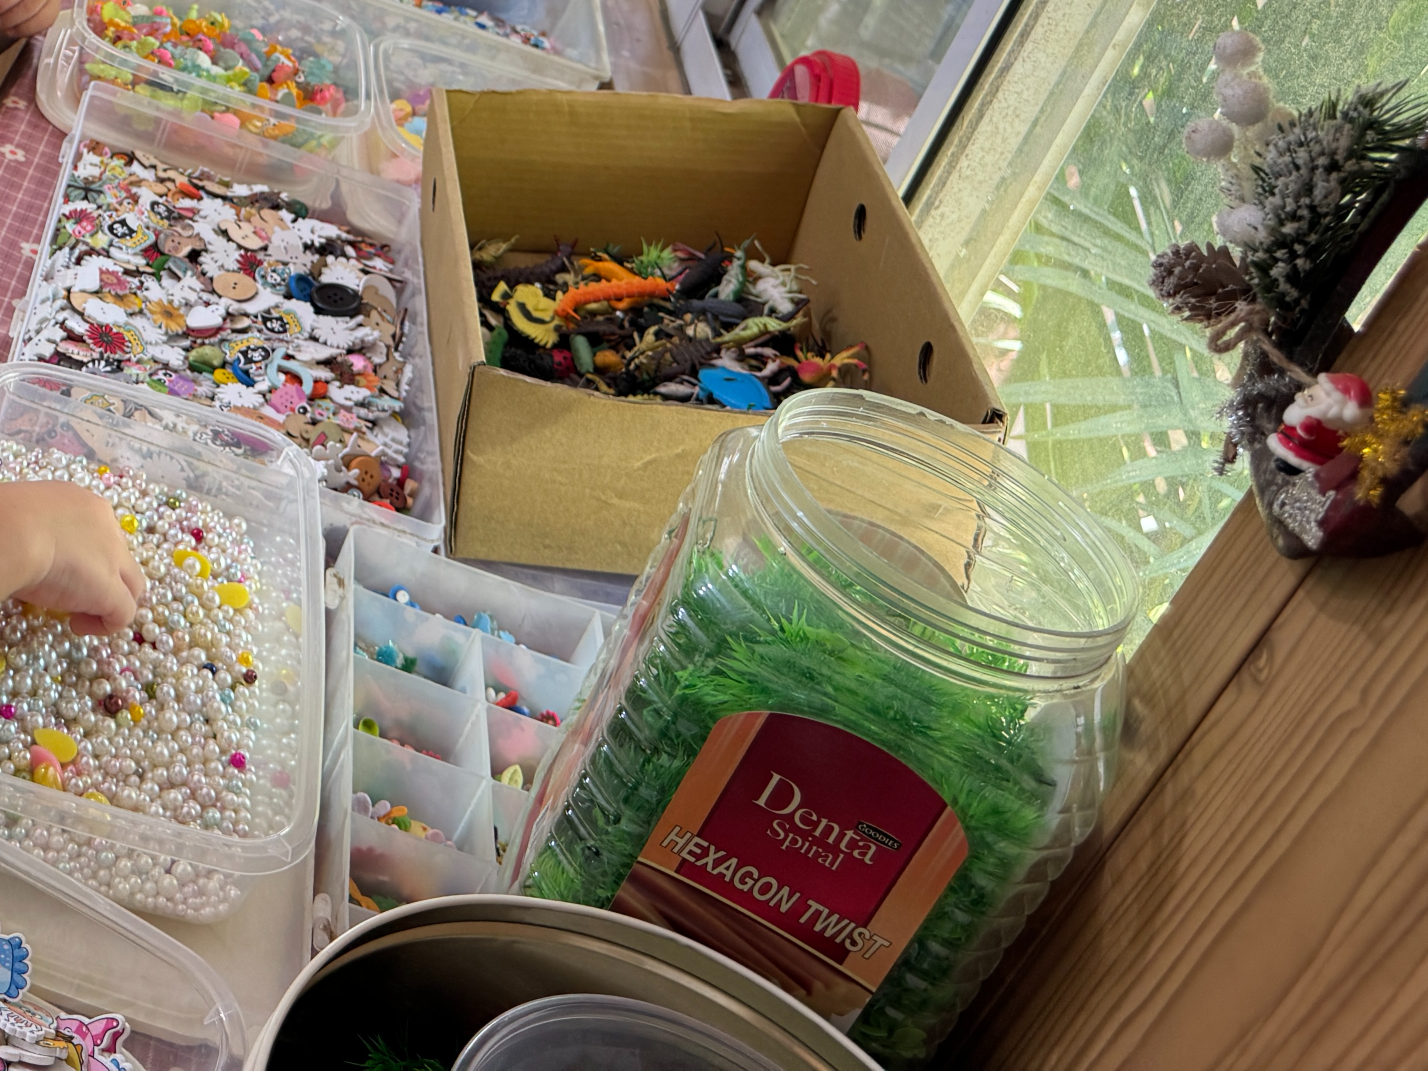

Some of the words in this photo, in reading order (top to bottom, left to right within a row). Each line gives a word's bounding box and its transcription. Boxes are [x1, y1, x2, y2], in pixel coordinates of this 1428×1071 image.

[752, 771, 874, 865] Denta
[766, 819, 844, 871] Spiral
[858, 823, 900, 849] GOODIES
[660, 825, 801, 913] HEXAGON
[798, 899, 892, 960] TWIST
